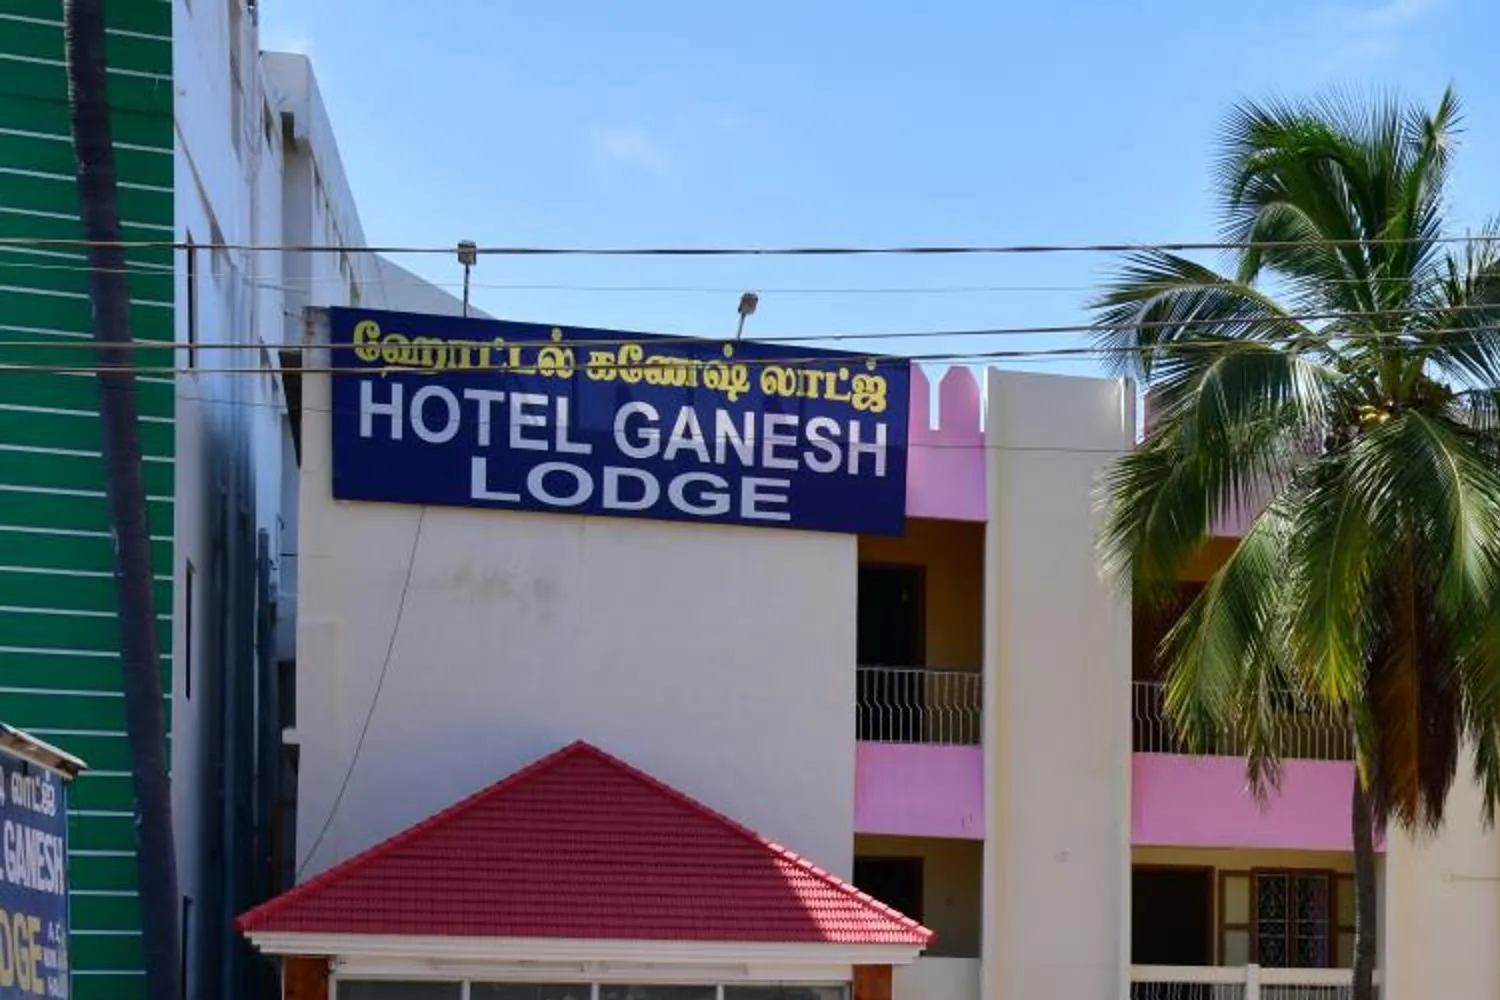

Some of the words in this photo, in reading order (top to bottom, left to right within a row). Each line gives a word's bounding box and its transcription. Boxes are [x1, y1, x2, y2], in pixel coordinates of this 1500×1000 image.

[586, 342, 751, 402] கணேஷ்
[760, 358, 888, 413] லாட்ஜ்
[358, 380, 592, 455] HOTEL
[613, 401, 888, 477] GANESH
[470, 456, 792, 521] LODGE
[4, 819, 64, 895] GANESH
[0, 908, 45, 996] DGE
